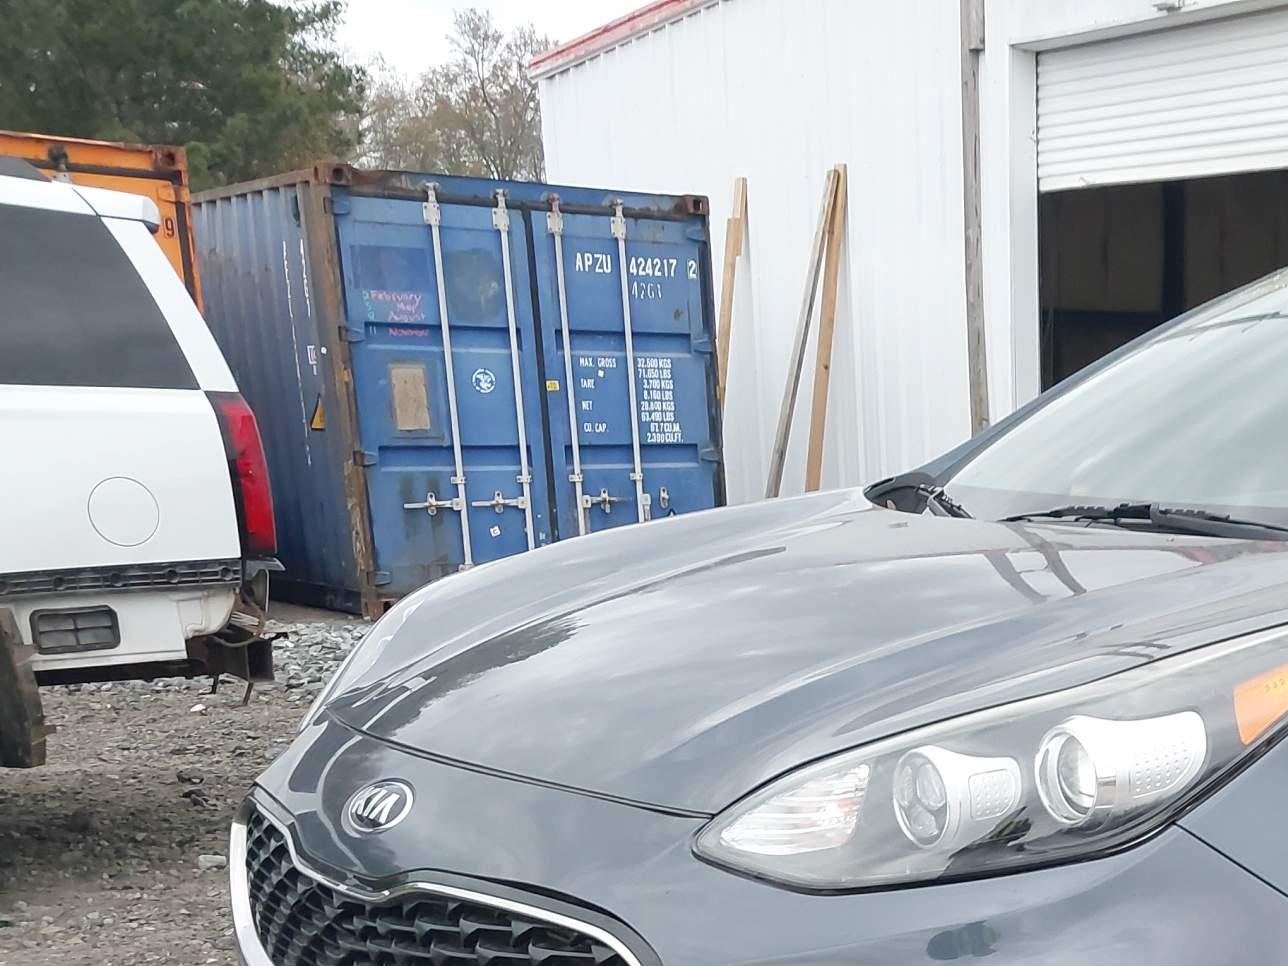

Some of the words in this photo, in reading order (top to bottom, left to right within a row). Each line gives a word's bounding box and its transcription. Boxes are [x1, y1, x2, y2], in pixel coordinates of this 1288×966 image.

[575, 252, 612, 273] APZU
[629, 256, 677, 277] 424217
[688, 259, 698, 279] 2
[597, 357, 617, 368] GROSS
[659, 358, 672, 369] KGS
[580, 378, 595, 389] TARE
[660, 379, 674, 390] KGS
[582, 400, 593, 411] NET
[351, 786, 401, 825] KIA
